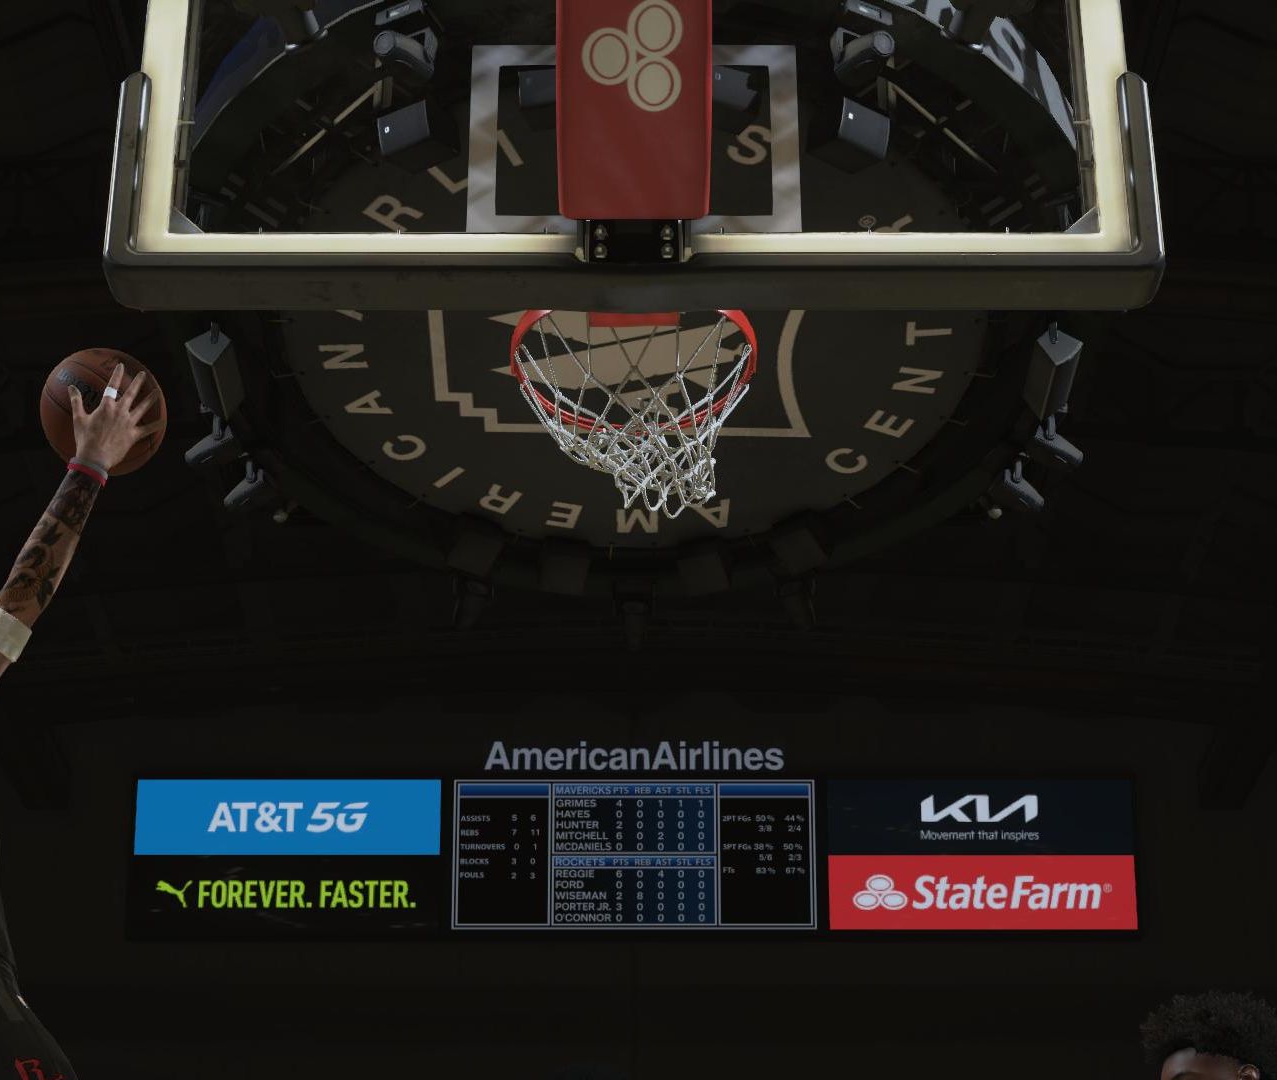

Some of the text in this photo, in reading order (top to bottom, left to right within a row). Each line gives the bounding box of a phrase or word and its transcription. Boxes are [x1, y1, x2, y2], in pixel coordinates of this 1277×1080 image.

[555, 786, 611, 795] MAVERICKS
[655, 786, 672, 795] AST
[676, 786, 692, 795] STL
[556, 800, 703, 808] GRIMES 4 0 1 1 1
[207, 801, 370, 833] AT&T 5G
[556, 810, 705, 818] HAYES 0 0 0 0 0
[556, 821, 705, 829] HUNTER 2 0 0 0 0
[556, 832, 705, 840] MITCHELL 6 0 2 0 0
[920, 829, 1040, 843] Movement that inspires
[556, 842, 705, 851] MCDANIELS 0 0 0 0 0
[555, 858, 605, 866] ROCKETS
[655, 858, 672, 866] AST
[676, 858, 692, 866] STL
[555, 870, 705, 878] REGGIE 6 0 4 0 0
[555, 881, 705, 889] FORD 0 0 0 0 0
[197, 879, 417, 910] FOREVER. FASTER.
[555, 892, 705, 900] WISEMAN 2 8 0 0 0
[555, 902, 595, 911] PORTER
[615, 902, 623, 911] 3
[636, 902, 644, 911] 0
[657, 902, 665, 911] 0
[677, 902, 685, 911] 0
[697, 902, 705, 911] 0
[555, 913, 705, 922] O'CONNOR 0 0 0 0 0
